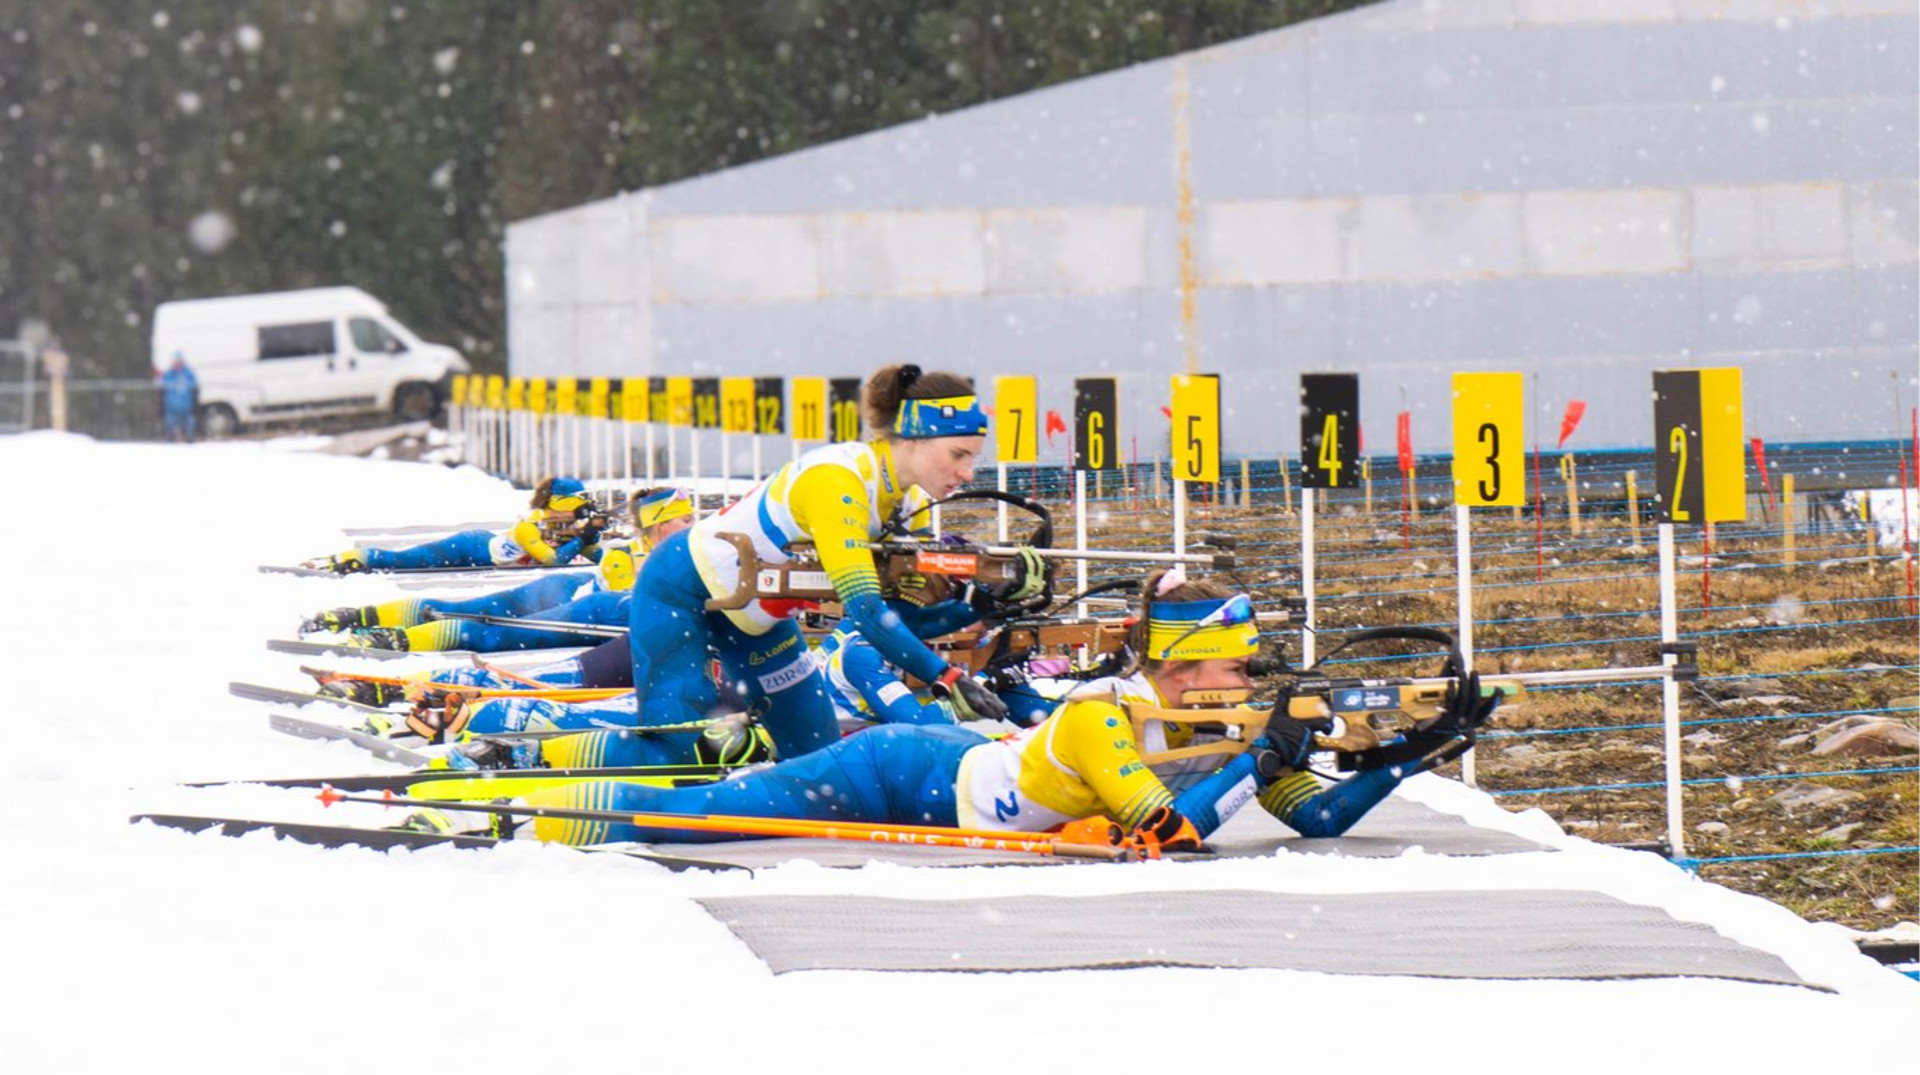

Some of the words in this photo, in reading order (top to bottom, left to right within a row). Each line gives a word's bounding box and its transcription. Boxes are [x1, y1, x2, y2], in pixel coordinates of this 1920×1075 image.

[696, 393, 716, 428] 14
[729, 397, 748, 431] 13
[757, 395, 780, 434] 12
[801, 402, 818, 439] 11
[832, 400, 859, 443] 10
[1008, 408, 1022, 460] 7
[1087, 411, 1104, 470] 6
[1187, 415, 1203, 478] 5
[1317, 413, 1343, 487] 4
[1477, 422, 1501, 502] 3
[1669, 426, 1690, 522] 2
[994, 790, 1020, 823] 2
[870, 830, 943, 846] ONE
